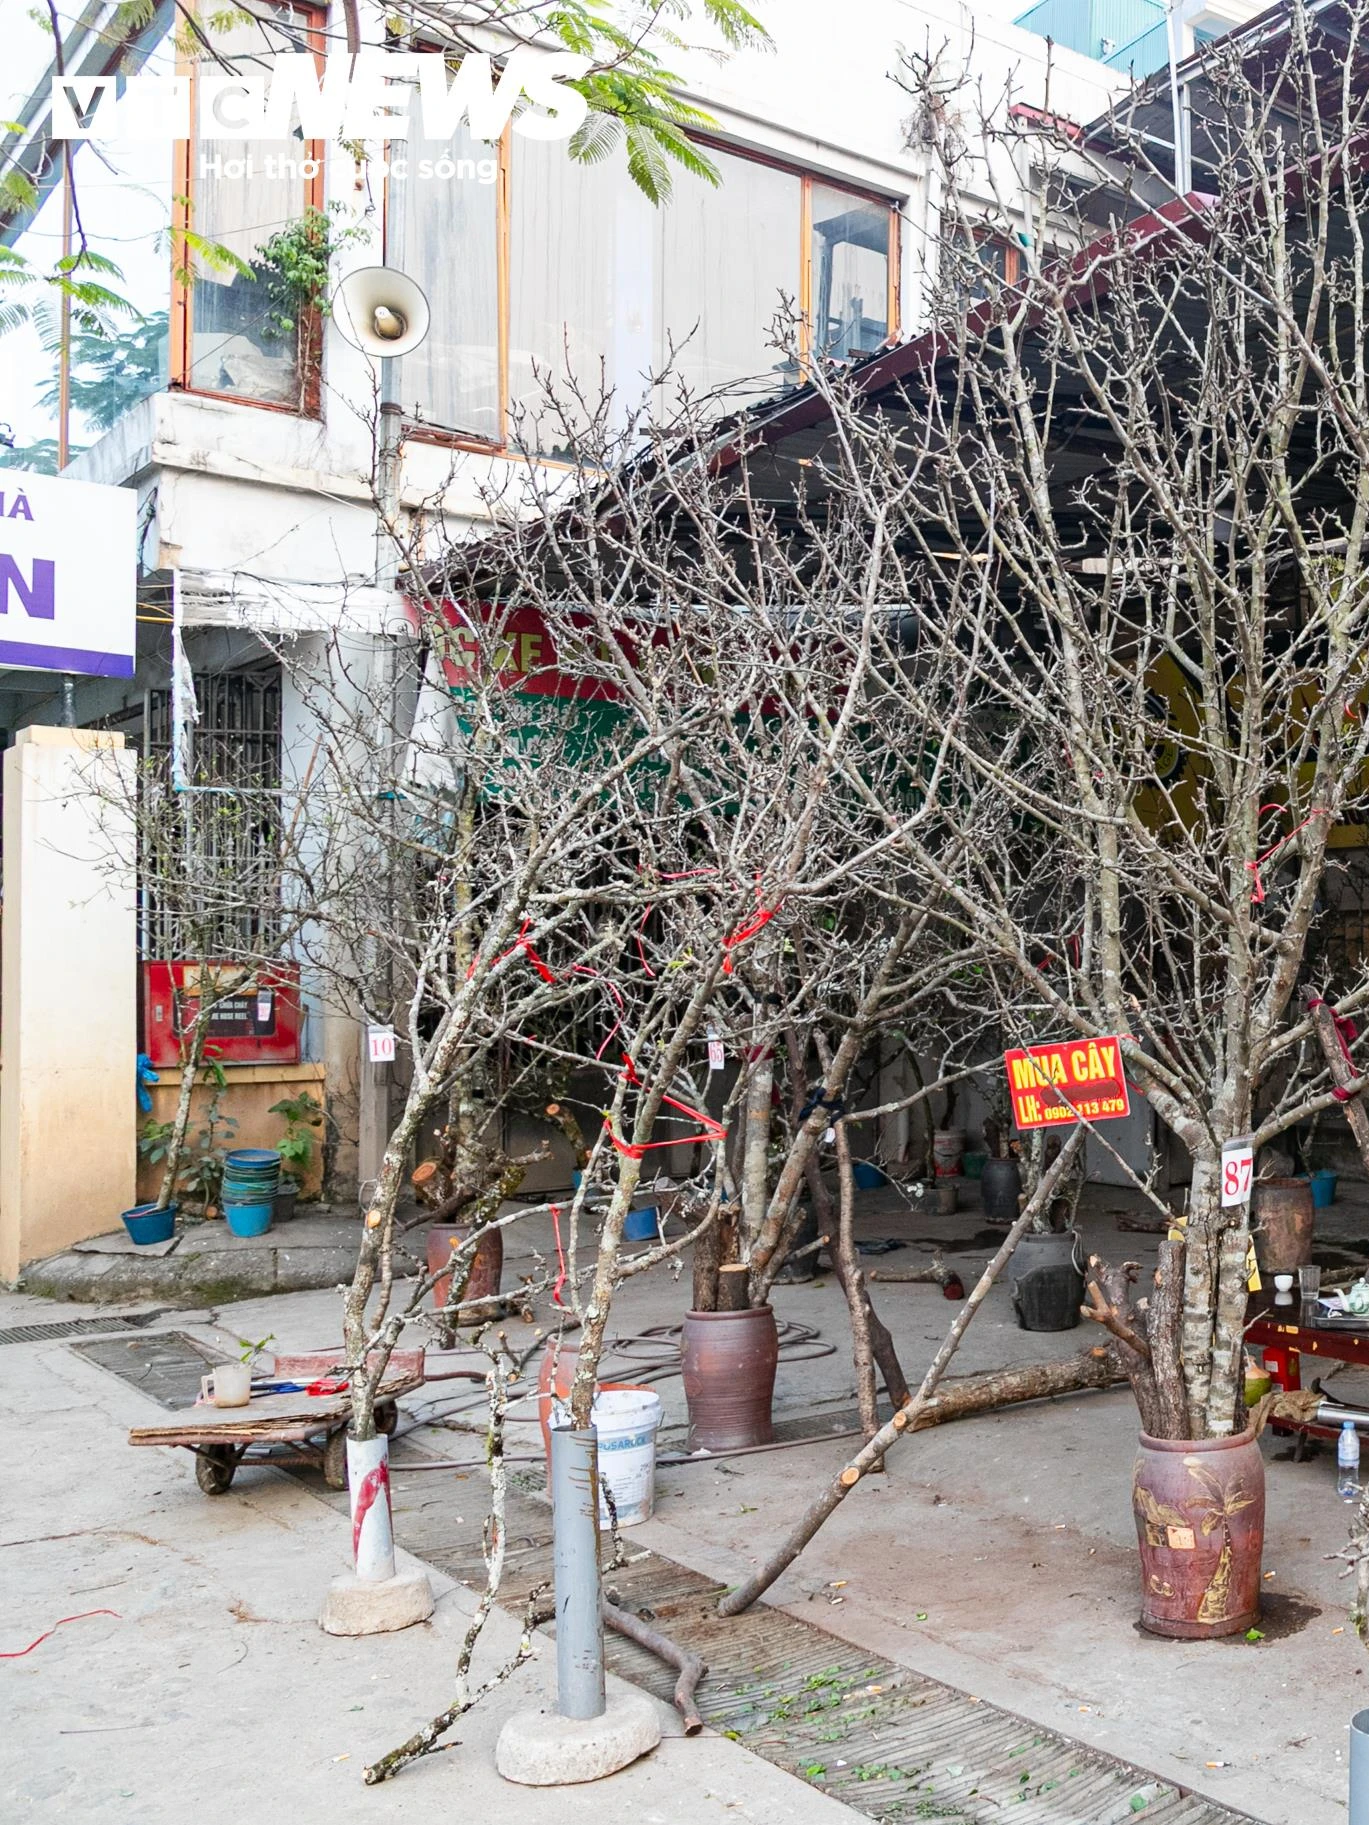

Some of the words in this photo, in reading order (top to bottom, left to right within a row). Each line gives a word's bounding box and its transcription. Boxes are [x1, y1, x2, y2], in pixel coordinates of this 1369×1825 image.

[372, 1038, 392, 1057] 10
[1012, 1054, 1068, 1090] MUA
[1071, 1042, 1117, 1082] CÂY
[1018, 1095, 1042, 1124] LH:
[1102, 1098, 1125, 1113] 479
[1224, 1157, 1254, 1196] 87
